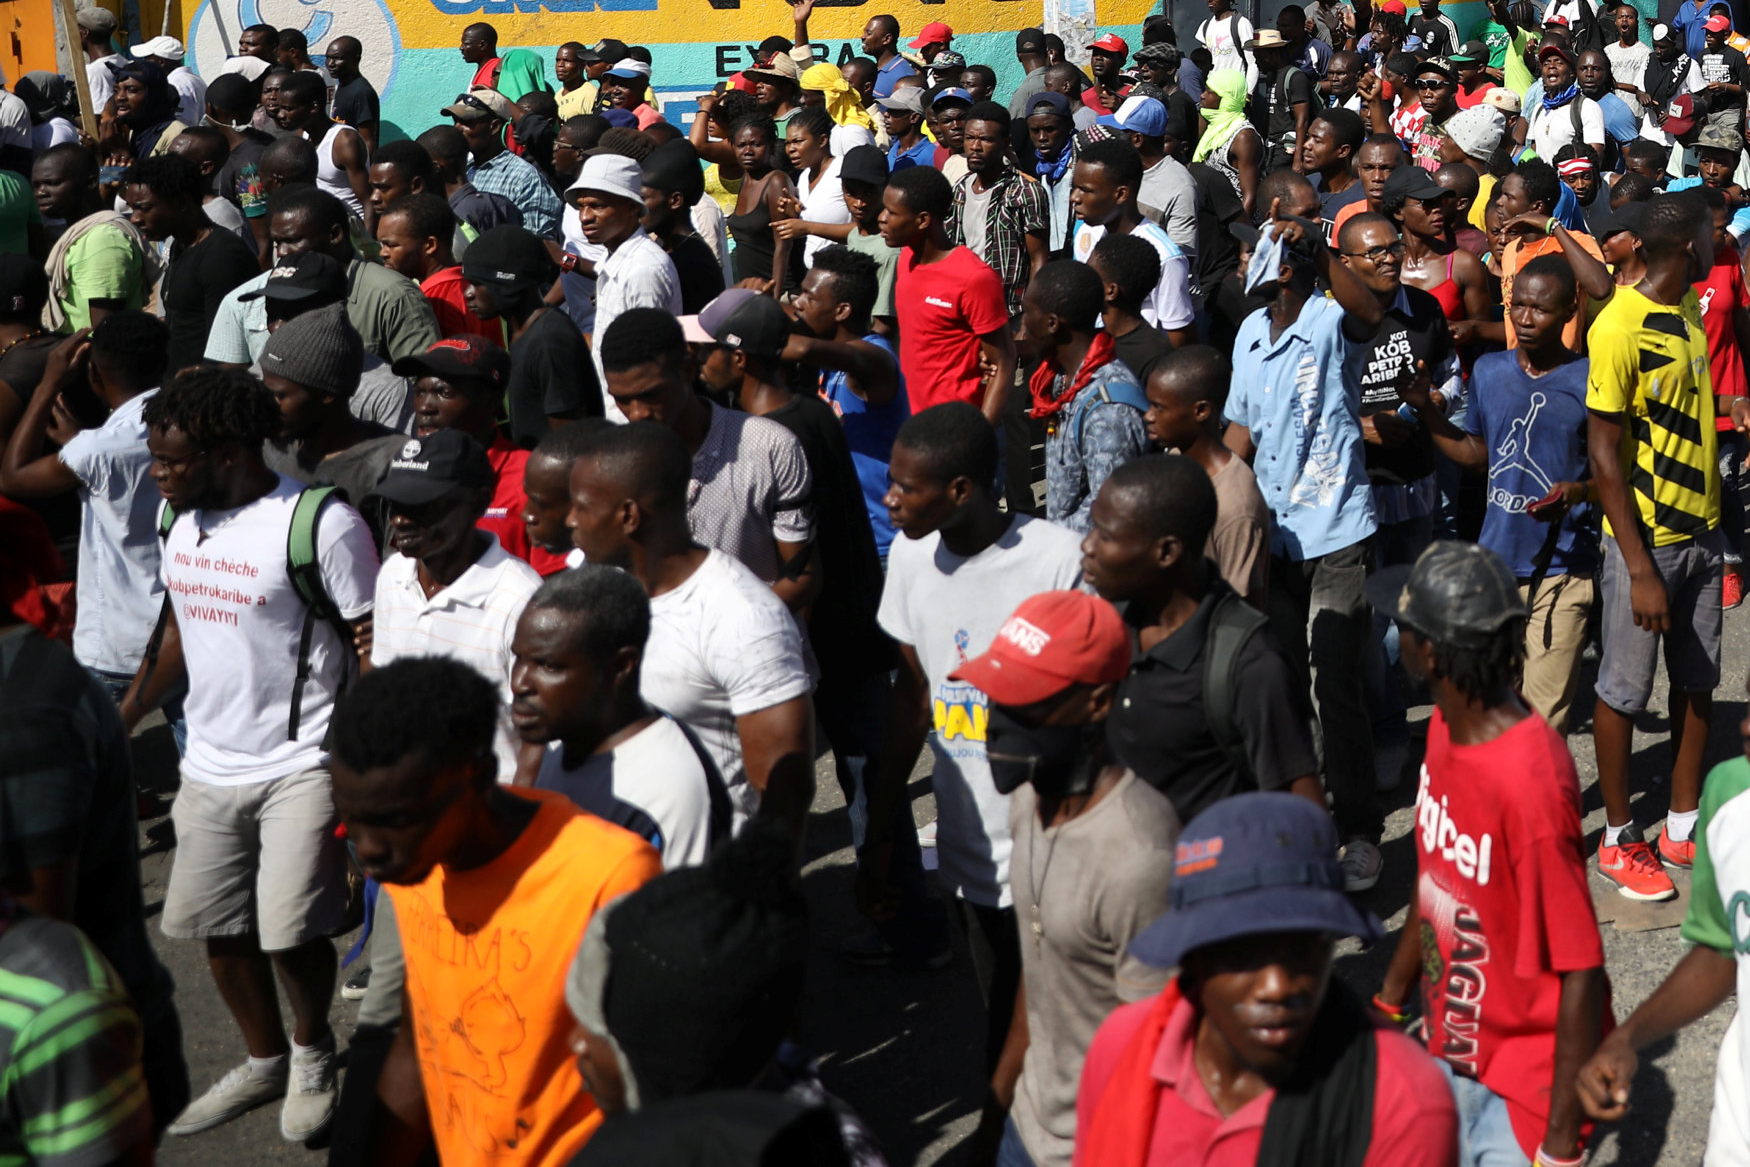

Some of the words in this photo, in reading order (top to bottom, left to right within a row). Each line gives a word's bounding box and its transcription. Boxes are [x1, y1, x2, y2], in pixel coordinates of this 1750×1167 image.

[715, 42, 860, 76] EXRA
[1390, 330, 1408, 341] KOT
[1488, 486, 1539, 513] JORDA
[174, 551, 192, 566] nou
[195, 554, 211, 570] vin
[167, 577, 252, 606] kobpetrokaribe
[257, 594, 266, 606] a
